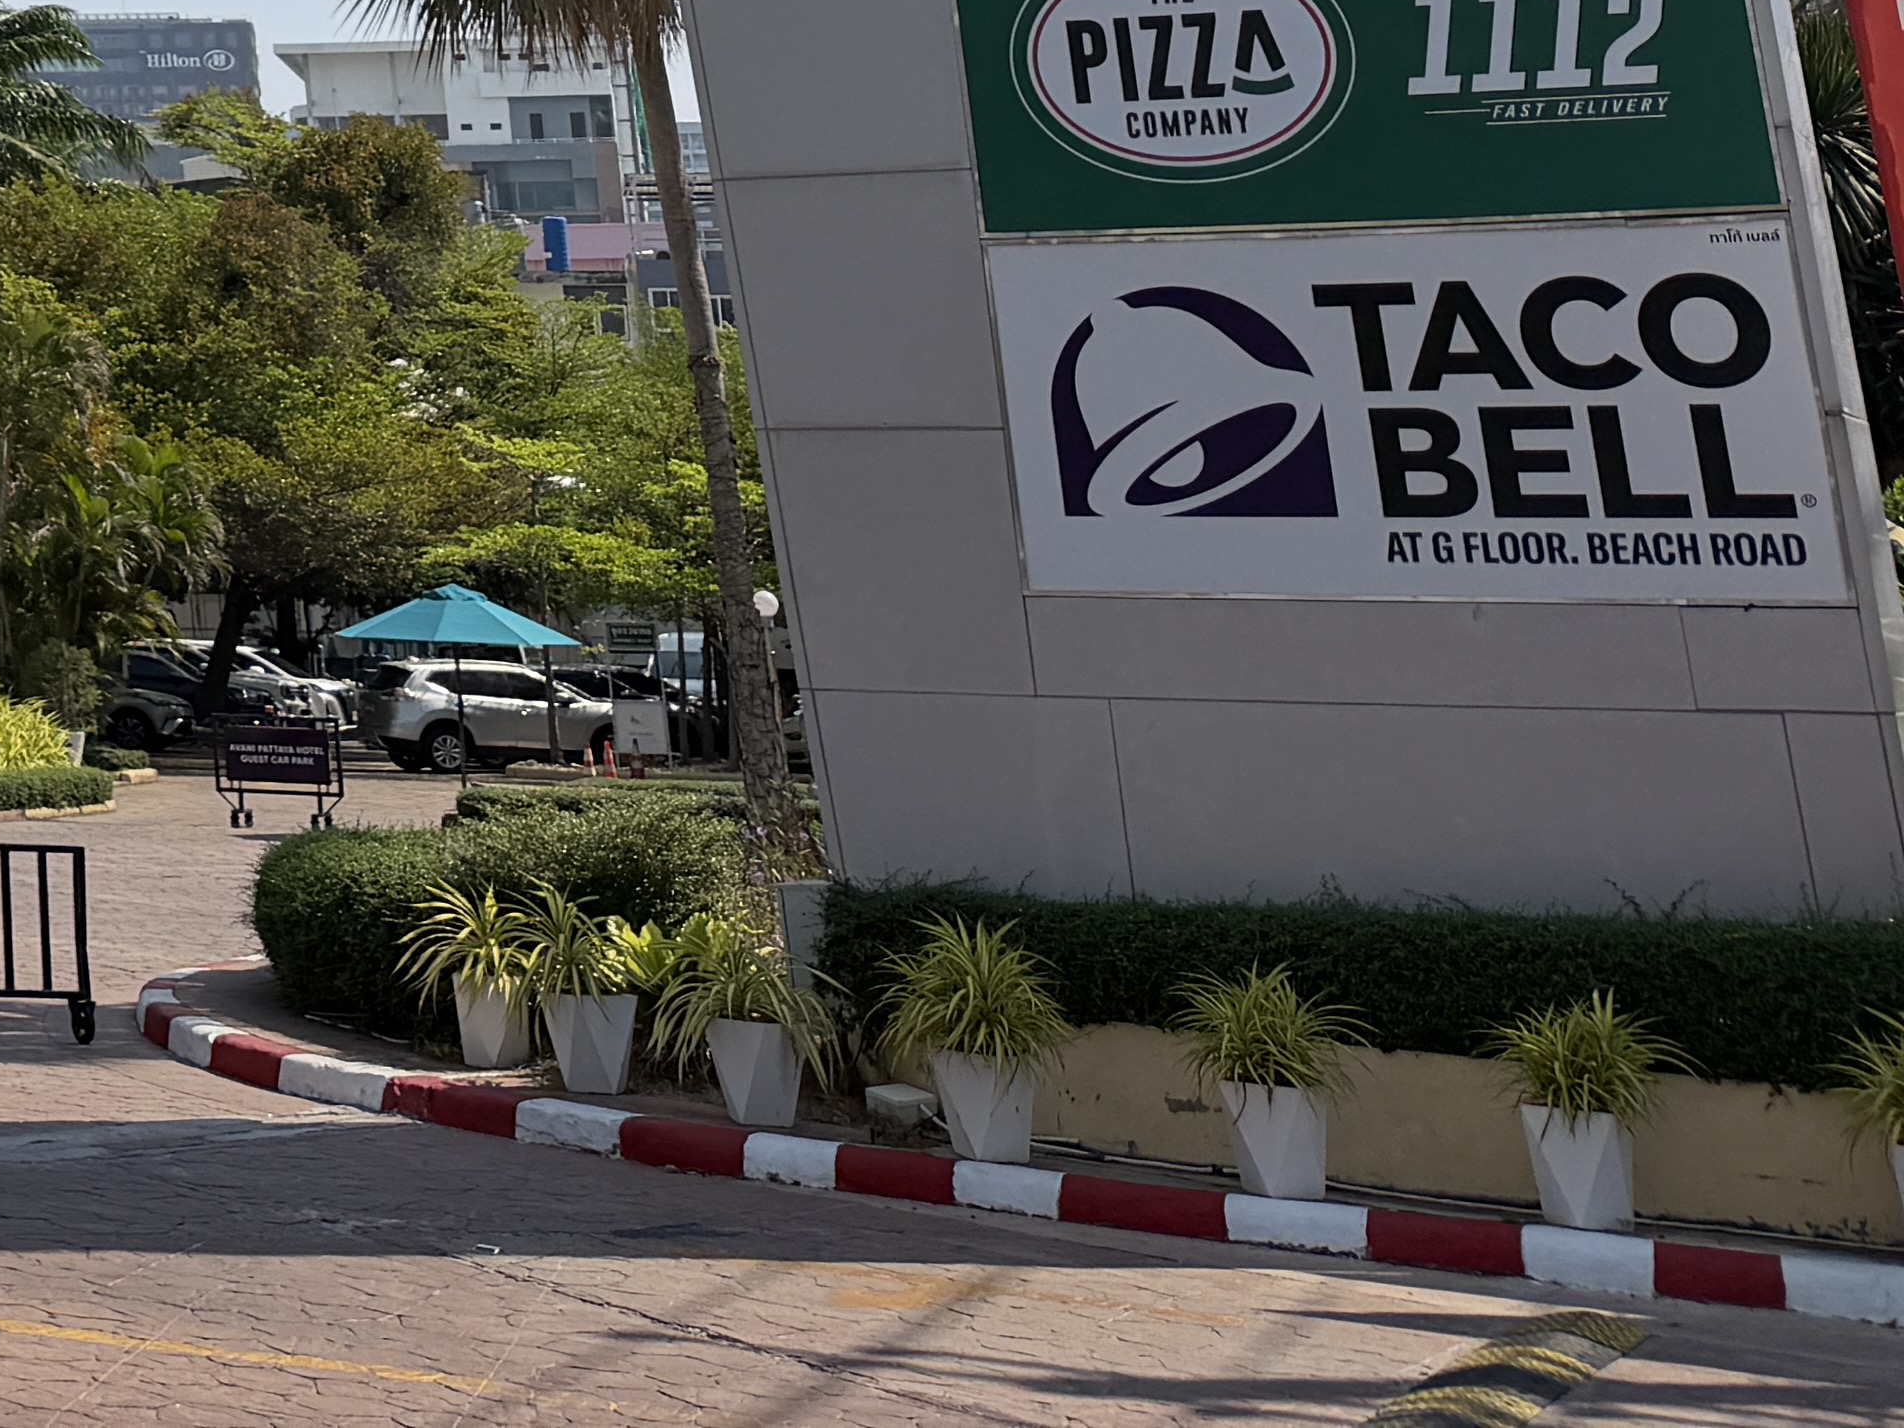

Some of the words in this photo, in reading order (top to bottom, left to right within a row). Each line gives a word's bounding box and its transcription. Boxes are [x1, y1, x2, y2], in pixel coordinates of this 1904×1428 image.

[147, 52, 201, 67] Hilton
[1064, 8, 1295, 105] PIZZA
[1124, 106, 1250, 139] COMPANY
[1493, 102, 1546, 120] FAST
[1557, 96, 1669, 116] DELIVERY
[1311, 272, 1772, 393] TACO
[1368, 404, 1798, 520] BELL
[1387, 532, 1425, 563] AT
[1431, 532, 1455, 564] G
[1463, 532, 1579, 565] FLOOR.
[1590, 533, 1702, 566] BEACH
[1710, 534, 1808, 567] ROAD
